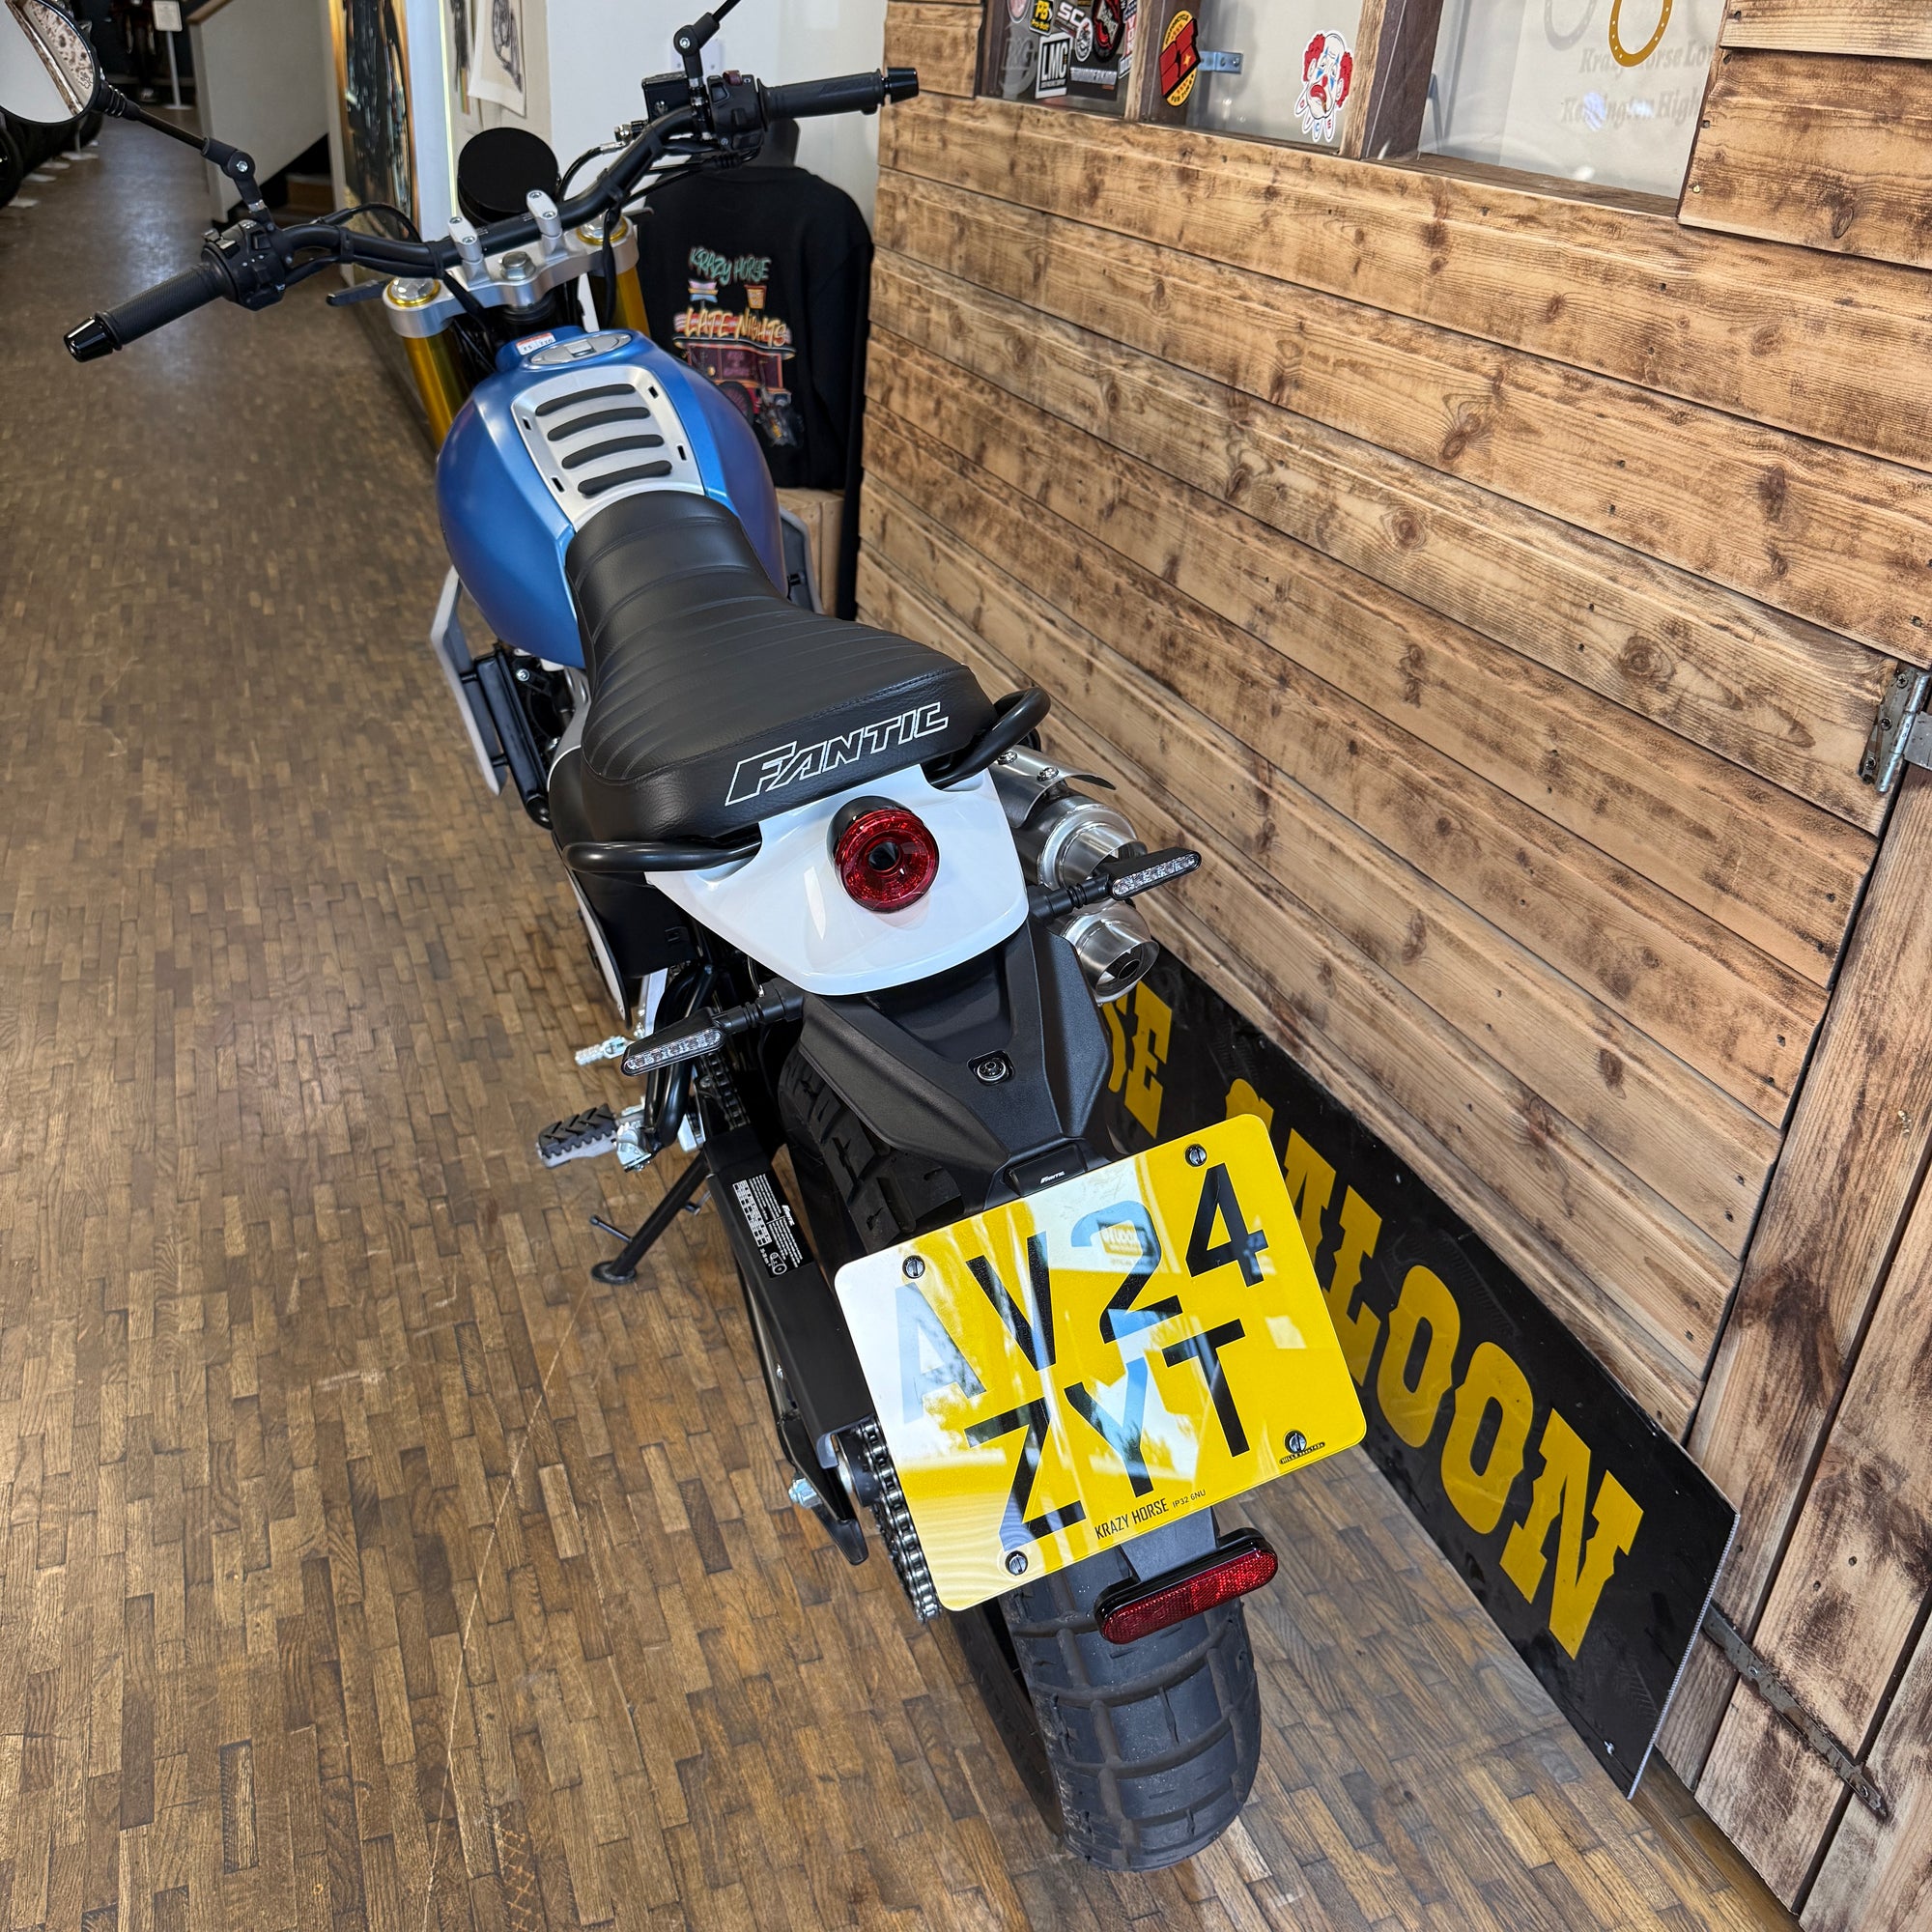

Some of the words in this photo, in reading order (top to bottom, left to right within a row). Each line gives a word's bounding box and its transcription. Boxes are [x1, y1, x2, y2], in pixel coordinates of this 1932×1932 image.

[1041, 42, 1068, 81] LMC
[684, 308, 733, 338] LATE
[724, 701, 949, 807] FANTIC
[895, 1164, 1268, 1424] AV24
[965, 1319, 1251, 1552] ZYT
[1094, 1514, 1130, 1540] KRAZY
[1131, 1497, 1170, 1524] HORSE
[1172, 1496, 1189, 1509] IP32
[1190, 1489, 1207, 1501] 6NU
